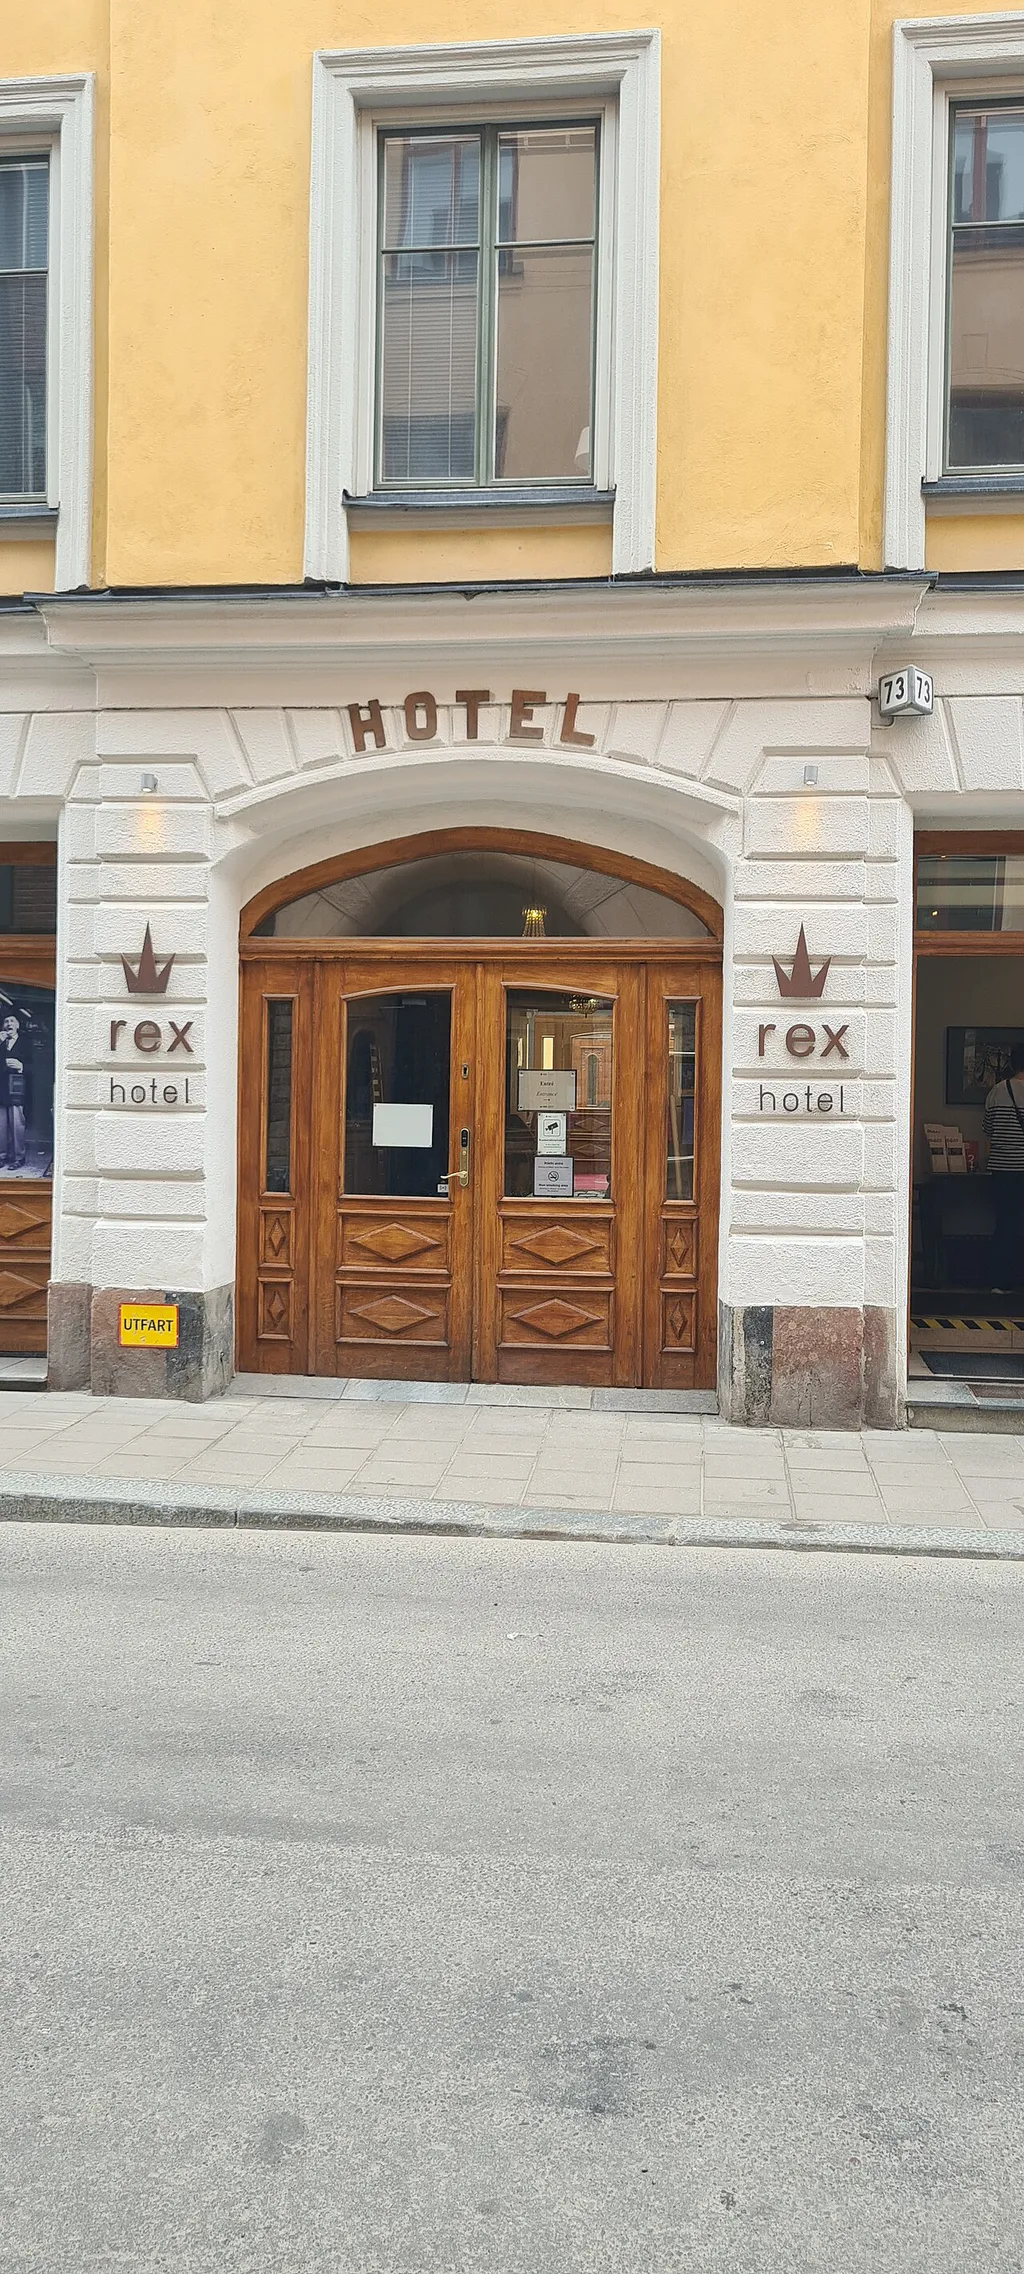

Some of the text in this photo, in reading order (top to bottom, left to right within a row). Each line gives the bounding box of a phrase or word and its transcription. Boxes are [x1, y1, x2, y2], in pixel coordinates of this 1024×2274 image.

[884, 676, 905, 704] 73
[917, 676, 931, 703] 73
[348, 689, 595, 752] HOTEL
[110, 1019, 195, 1053] rex
[758, 1023, 850, 1057] rex
[110, 1077, 189, 1104] hotel
[759, 1084, 844, 1112] hotel
[123, 1318, 174, 1332] UTFART
